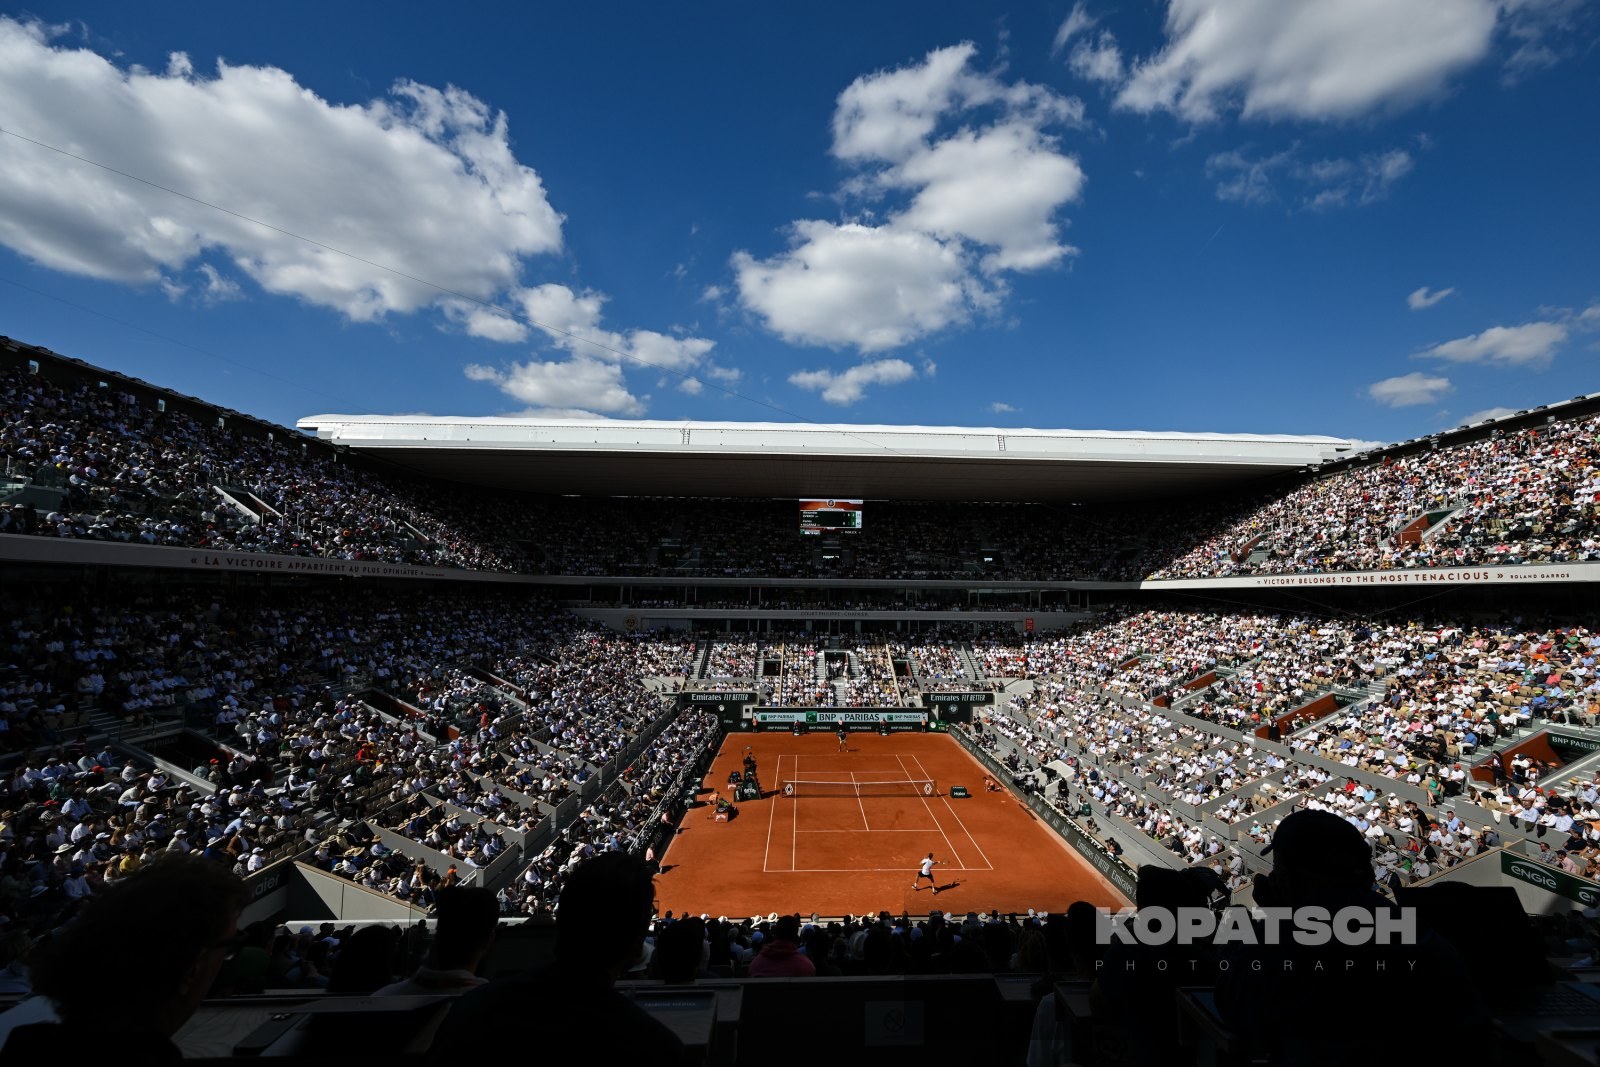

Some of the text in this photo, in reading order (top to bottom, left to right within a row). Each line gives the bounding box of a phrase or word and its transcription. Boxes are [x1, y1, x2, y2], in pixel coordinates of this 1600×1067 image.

[204, 556, 219, 566] LA
[226, 558, 283, 568] VICTOIRE
[288, 560, 346, 572] APPARTIENT
[1414, 572, 1488, 581] TENACIOUS
[1570, 740, 1600, 750] PARIBA
[1076, 838, 1094, 859] Emirates
[1098, 858, 1110, 872] BETTER
[1111, 869, 1134, 895] Emirates
